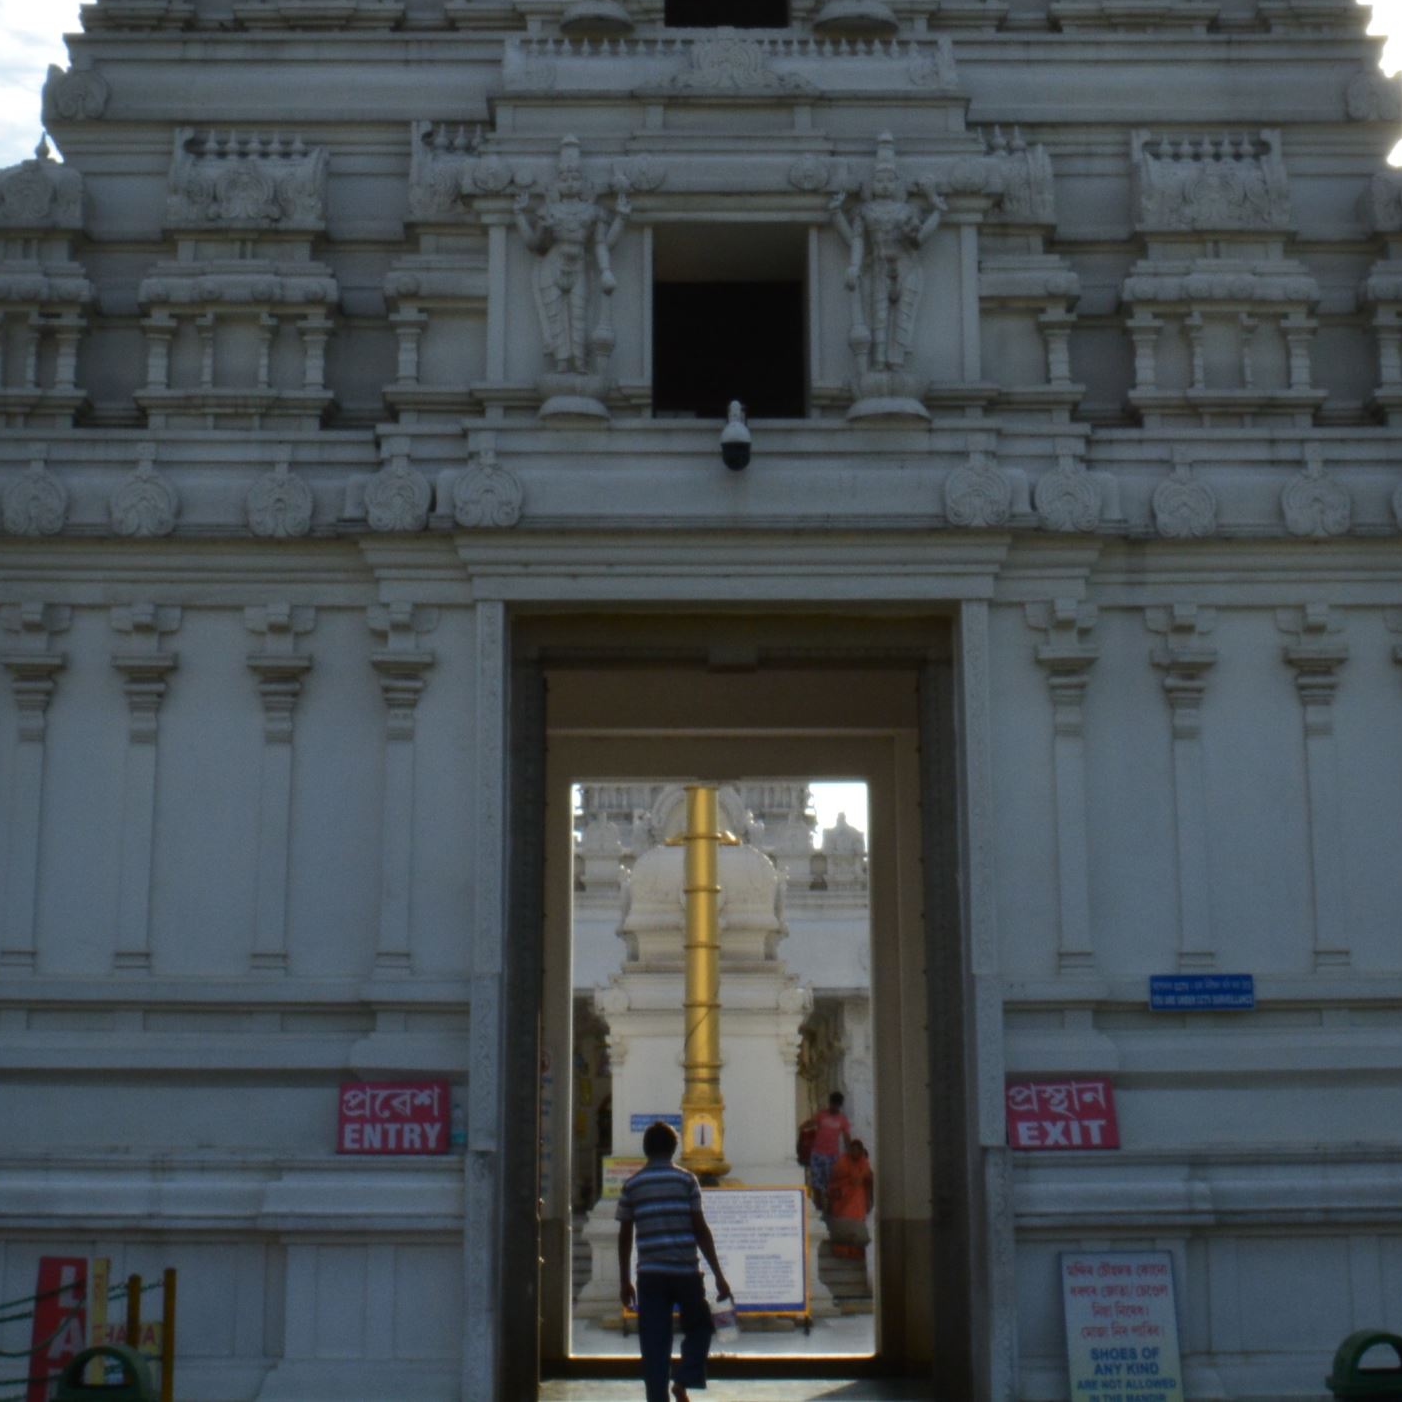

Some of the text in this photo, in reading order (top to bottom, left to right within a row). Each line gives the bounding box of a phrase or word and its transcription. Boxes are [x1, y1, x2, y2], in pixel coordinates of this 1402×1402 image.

[343, 1122, 443, 1150] ENTRY
[1016, 1119, 1107, 1146] EXIT
[1090, 1346, 1160, 1360] SHOES OF
[1094, 1362, 1159, 1375] ANY KIND
[1077, 1378, 1177, 1391] ARE NOT ALLOWED
